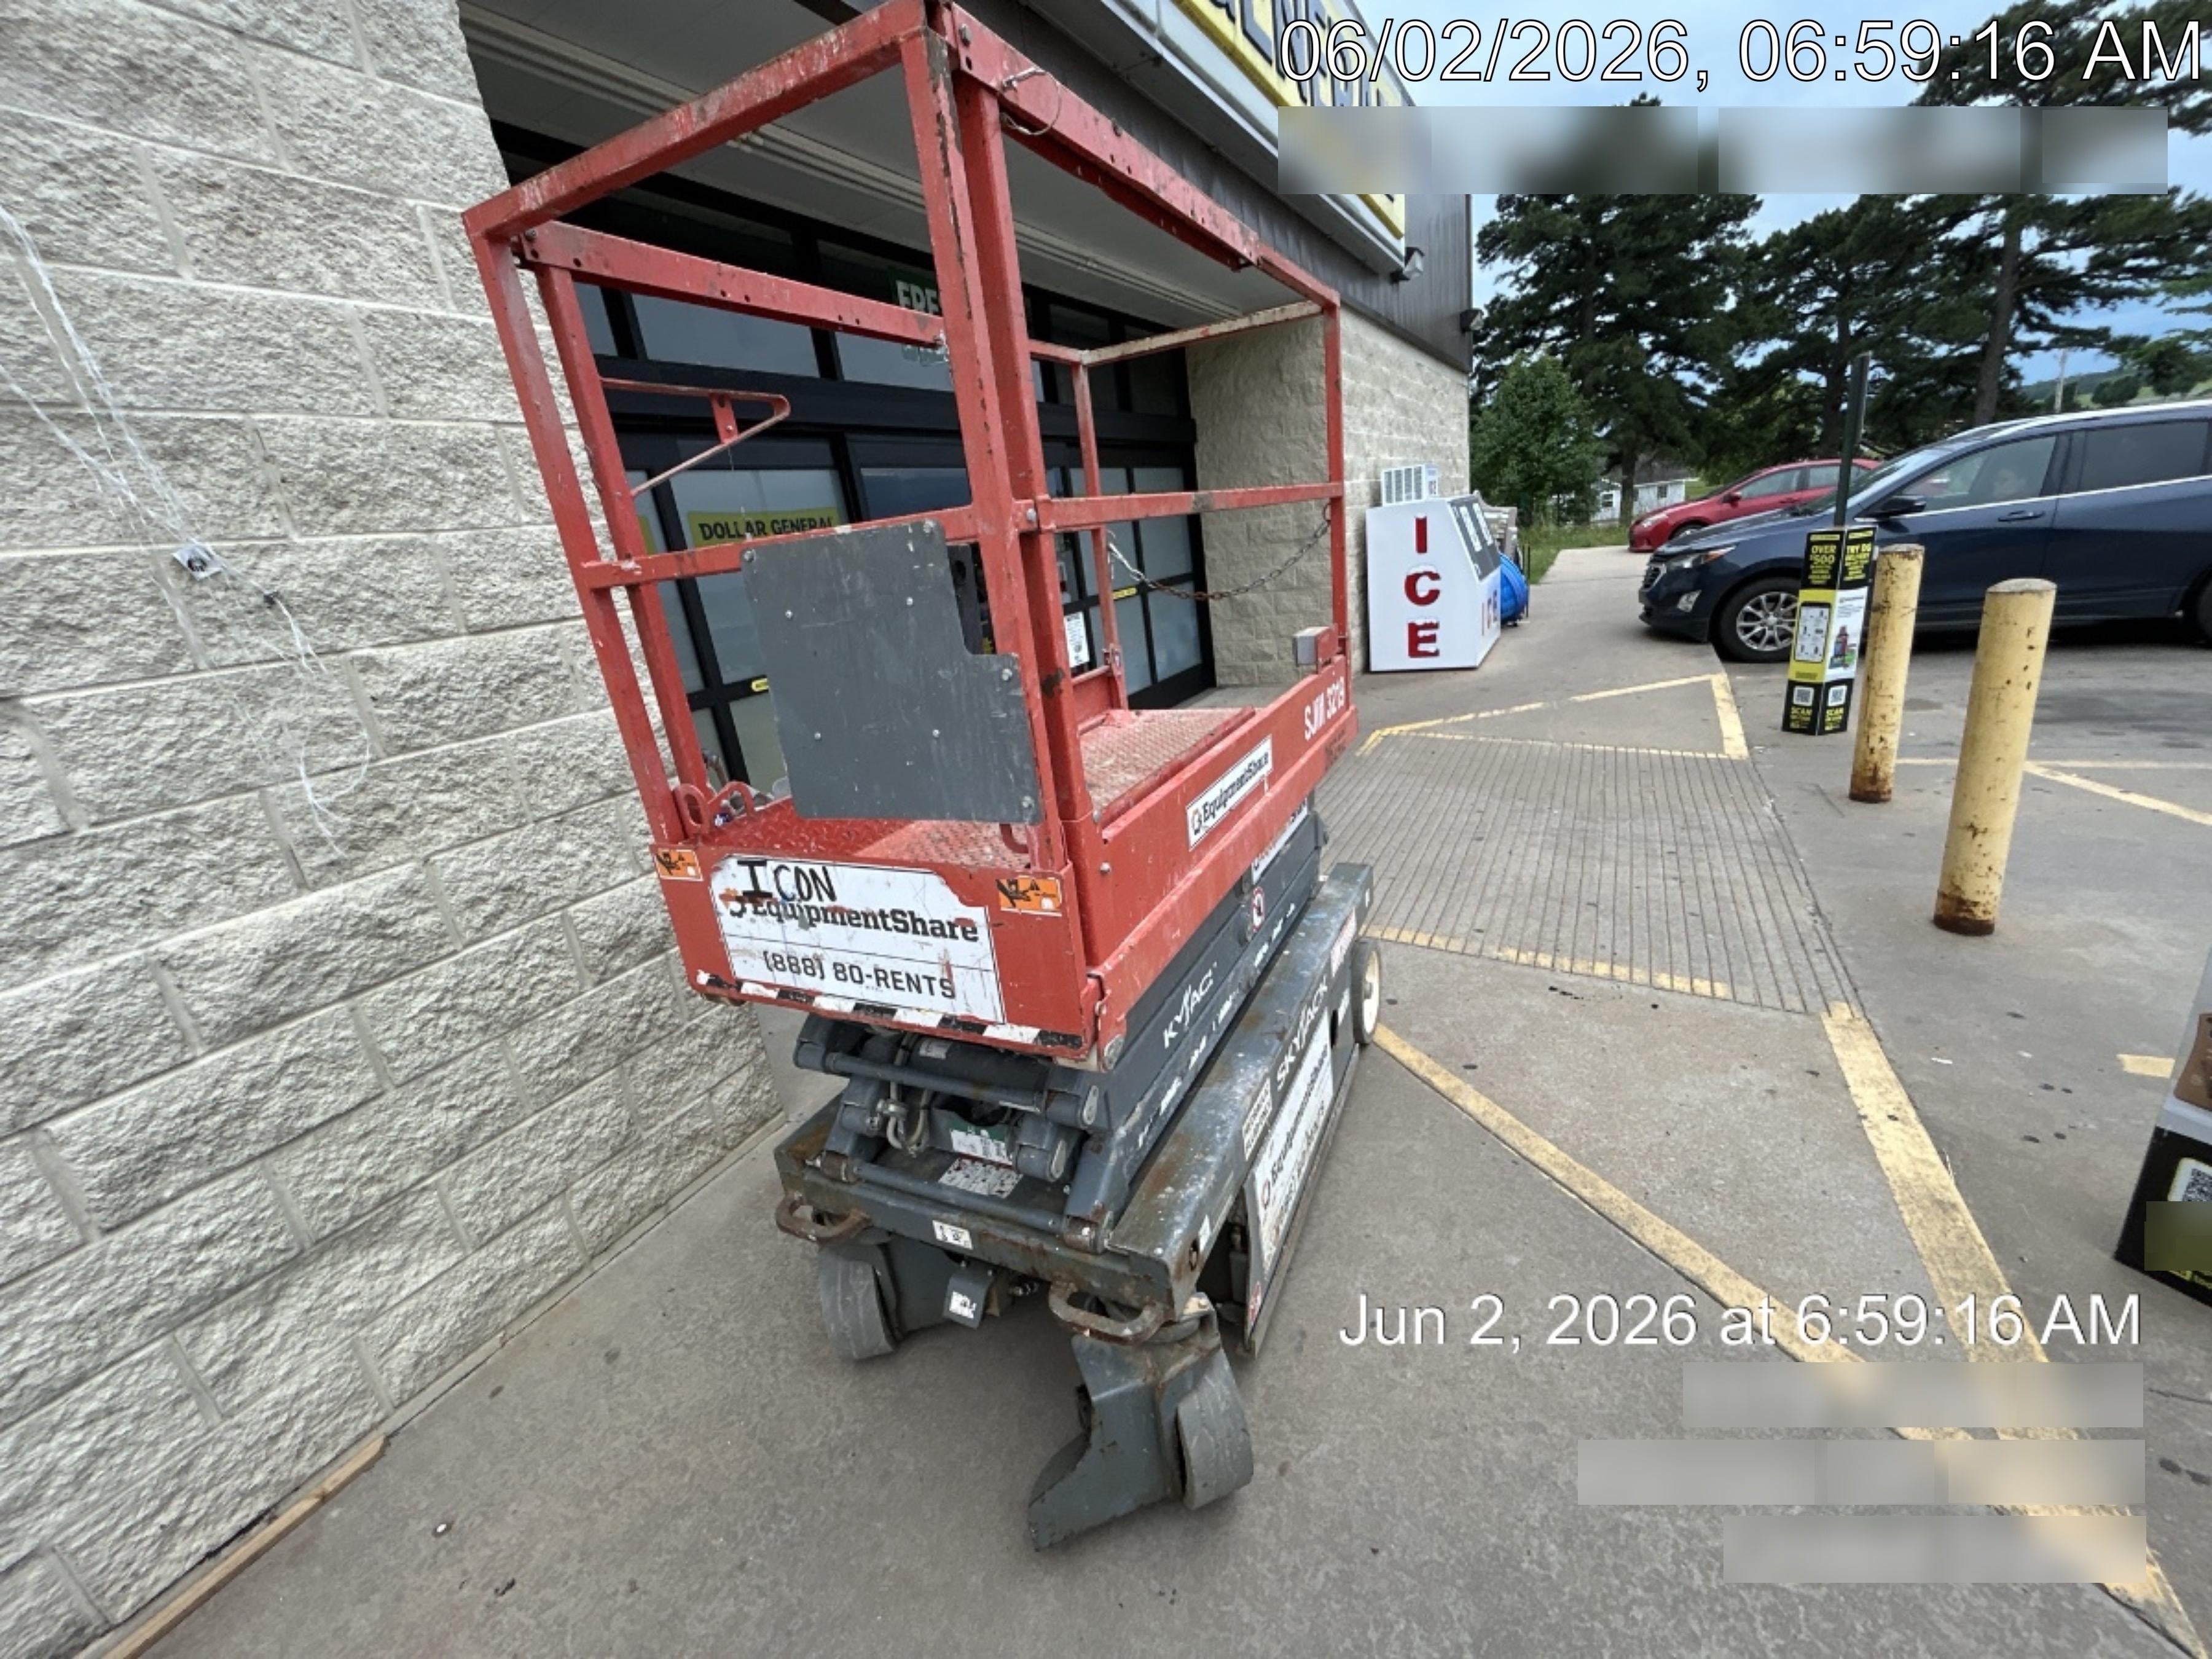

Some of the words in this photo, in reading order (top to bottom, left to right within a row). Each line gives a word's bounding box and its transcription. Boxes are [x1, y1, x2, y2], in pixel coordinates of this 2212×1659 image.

[896, 280, 941, 315] FRE
[699, 520, 767, 540] DOLLAR
[1404, 512, 1442, 659] ICE
[764, 950, 826, 980] (888)
